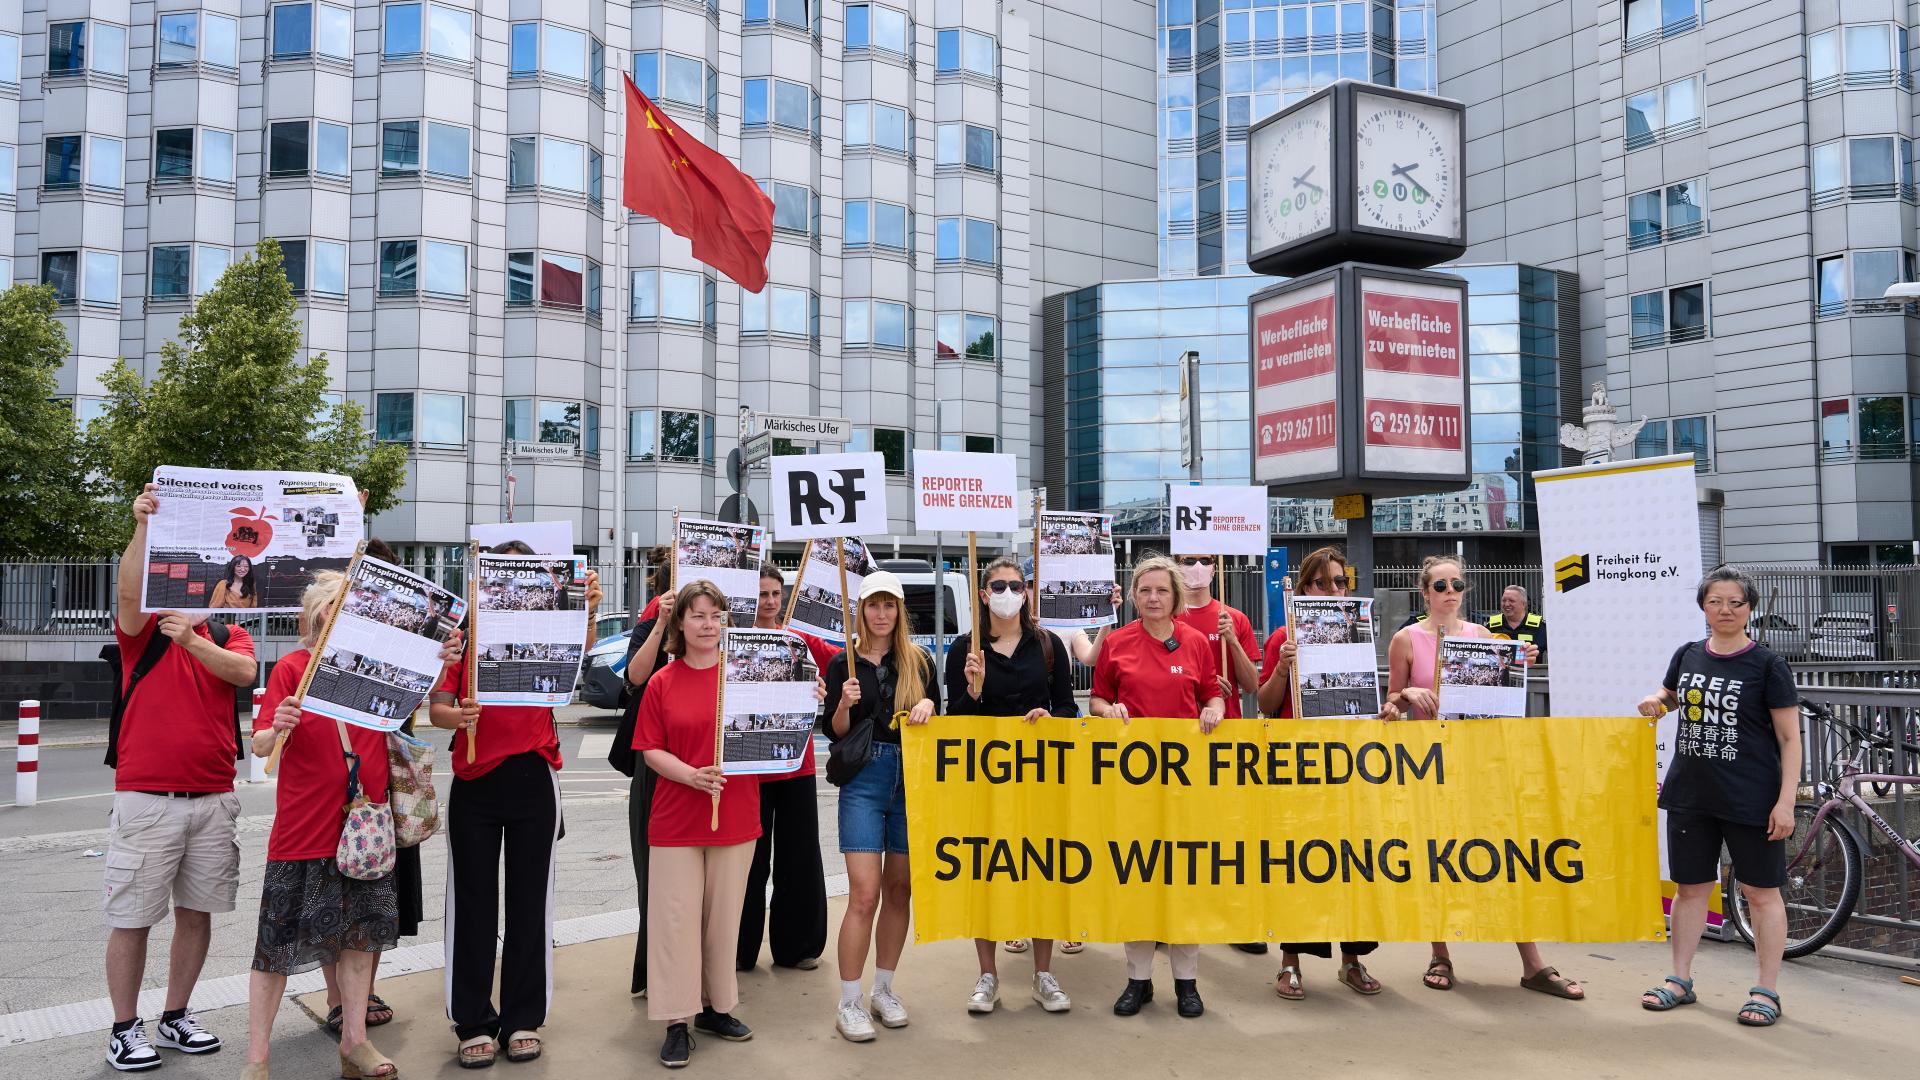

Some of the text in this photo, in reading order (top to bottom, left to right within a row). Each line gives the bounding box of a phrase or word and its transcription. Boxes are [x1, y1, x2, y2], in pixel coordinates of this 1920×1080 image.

[1260, 316, 1328, 346] Werbefläche
[1368, 309, 1452, 334] Werbefläche
[1260, 343, 1332, 371] zu vermieten
[1368, 339, 1456, 360] zu vermieten
[764, 418, 840, 434] Märkisches Ufer
[1276, 414, 1333, 442] 259 267 111
[1390, 413, 1458, 437] 259 267 111
[157, 477, 263, 491] Silenced voices
[922, 476, 984, 492] REPORTER
[788, 468, 866, 526] RSF
[922, 492, 1013, 509] OHNE GRENZEN
[1042, 521, 1066, 530] lives
[1176, 506, 1212, 530] RSF
[680, 529, 708, 540] lives
[1232, 524, 1261, 532] GRENZEN
[1596, 552, 1662, 566] Freiheit für
[362, 561, 377, 571] The
[377, 569, 398, 579] spirit
[480, 566, 536, 579] lives on
[1597, 566, 1679, 581] Hongkong e.V.
[357, 568, 394, 590] lives
[395, 585, 415, 596] on
[1295, 607, 1320, 616] lives
[730, 640, 760, 650] lives
[1444, 648, 1486, 659] lives on
[1171, 666, 1183, 674] RSF
[1678, 672, 1743, 694] FREE
[1680, 722, 1739, 743] 光復香港
[1678, 739, 1739, 762] 時代革命
[936, 738, 1446, 786] FIGHT FOR FREEDOM
[1872, 814, 1904, 847] Raleigh
[934, 836, 1585, 886] STAND WITH HONG KONG
